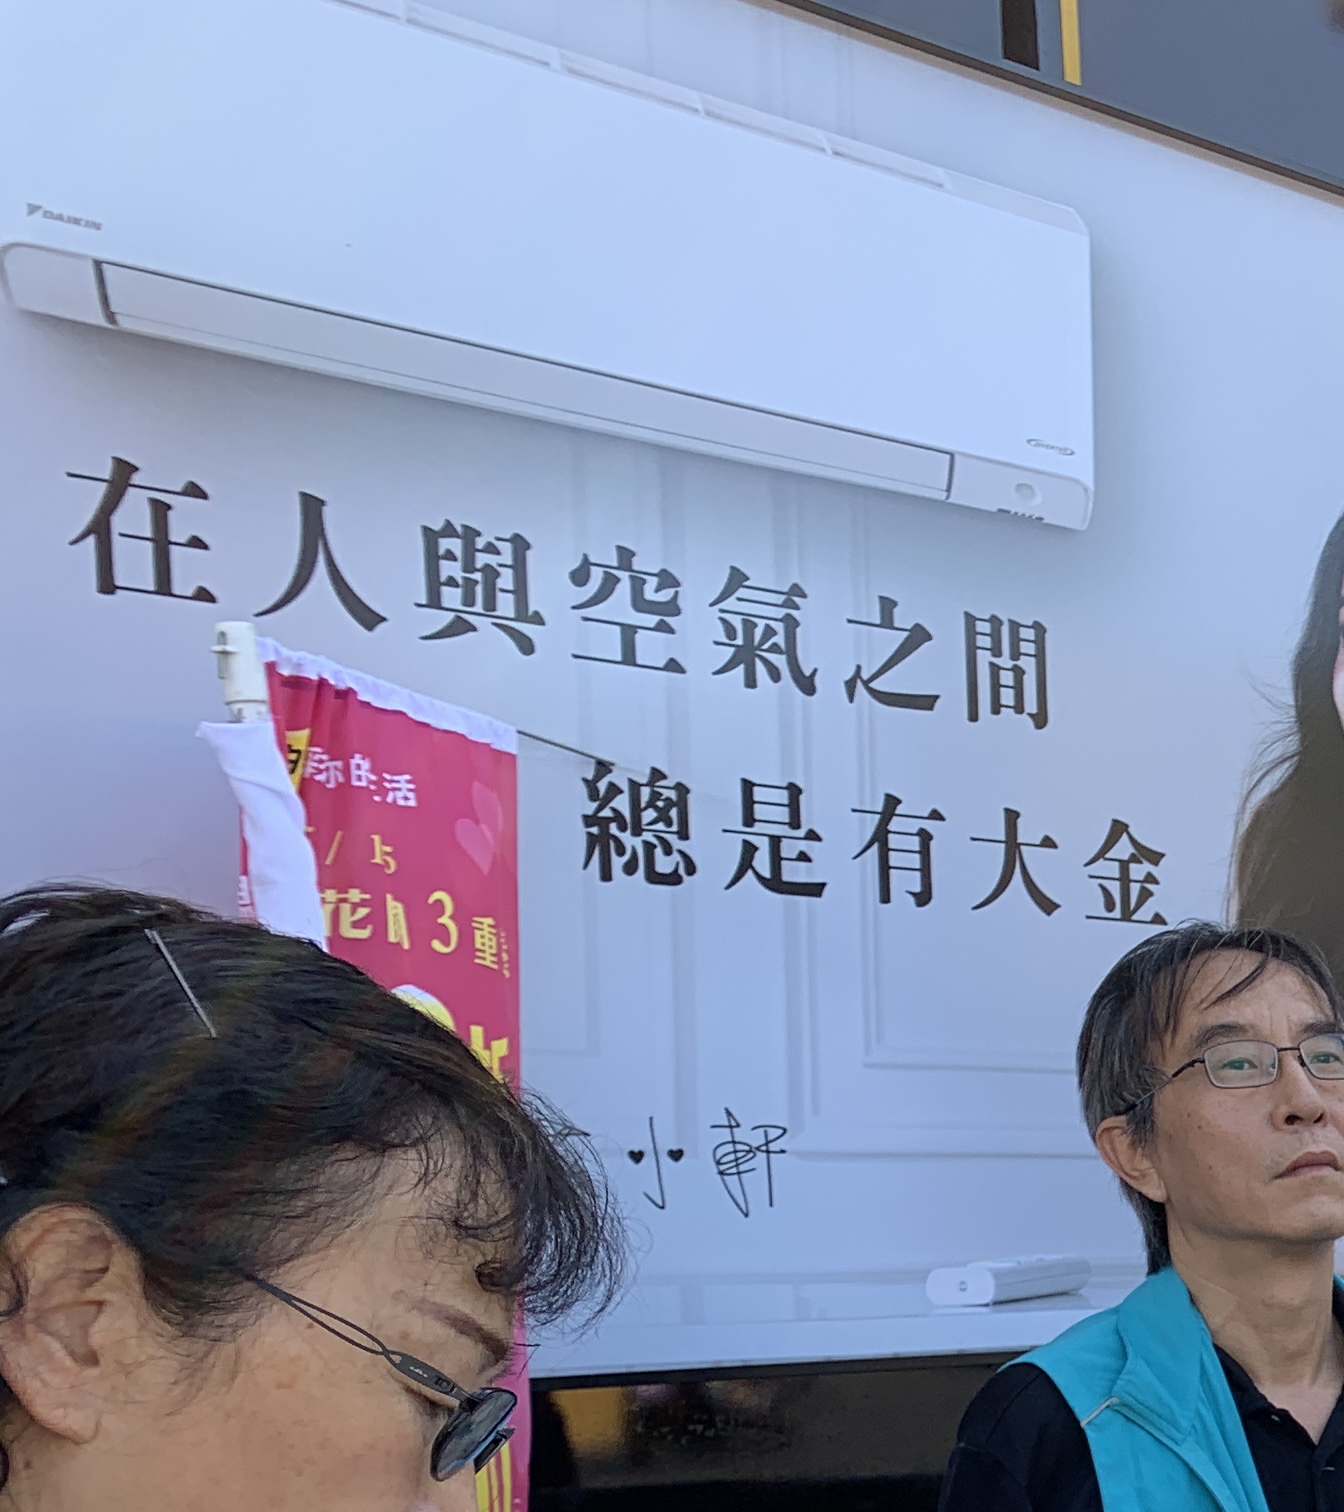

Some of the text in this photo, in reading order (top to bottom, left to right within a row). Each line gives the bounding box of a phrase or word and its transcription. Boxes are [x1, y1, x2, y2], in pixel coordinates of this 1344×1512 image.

[66, 455, 1049, 731] 在人與空氣之間
[580, 758, 1168, 927] 總是有大金
